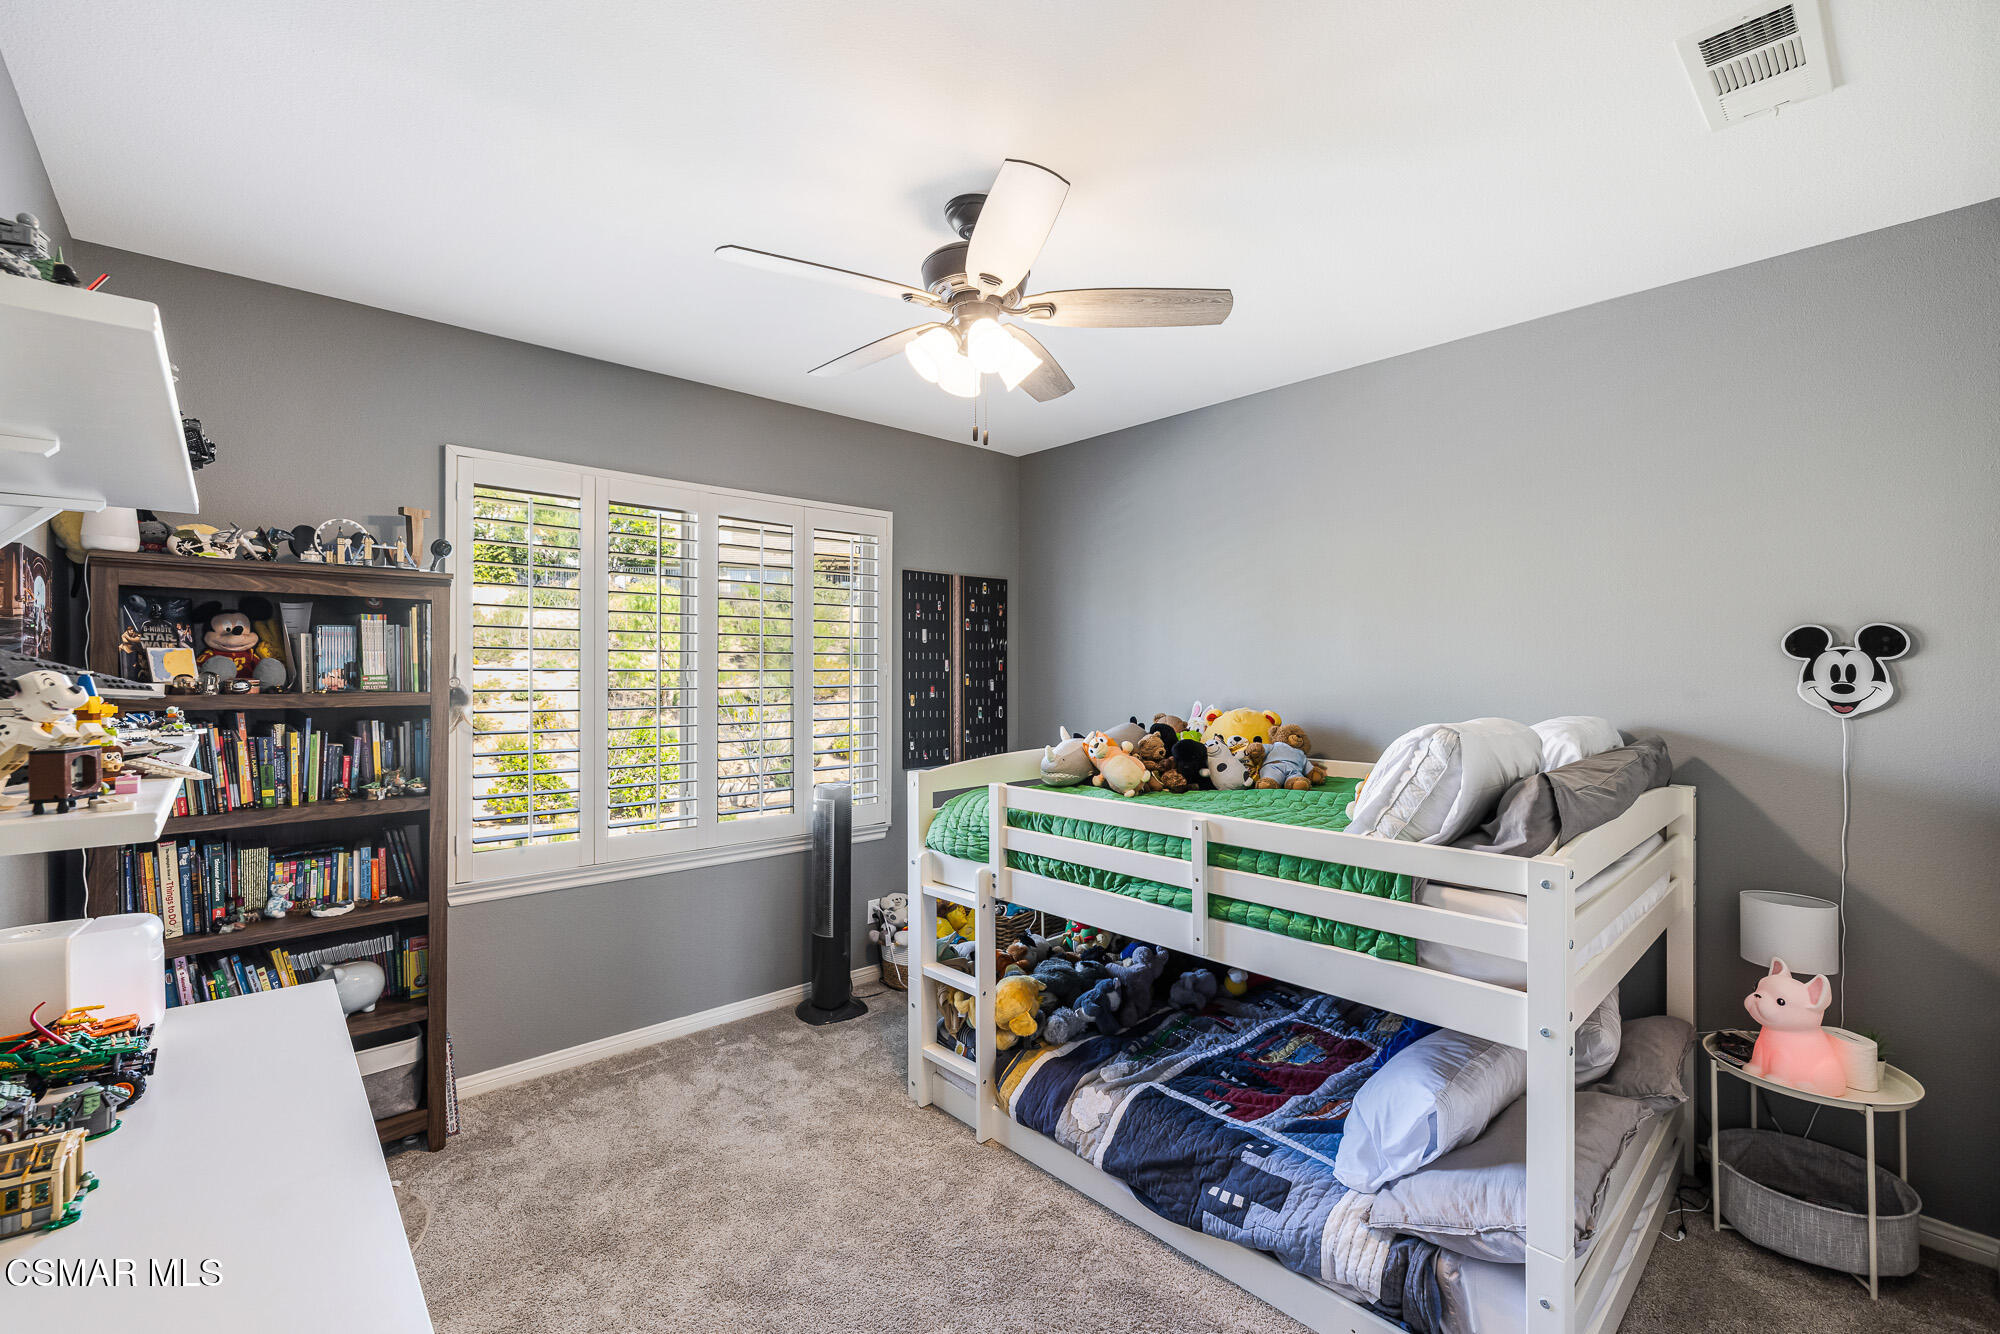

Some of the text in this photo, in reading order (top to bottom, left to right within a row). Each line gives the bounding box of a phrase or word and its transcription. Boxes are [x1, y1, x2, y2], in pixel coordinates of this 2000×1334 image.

[141, 632, 177, 642] STAR
[166, 881, 175, 905] Things
[168, 905, 176, 913] to
[168, 914, 177, 926] DO
